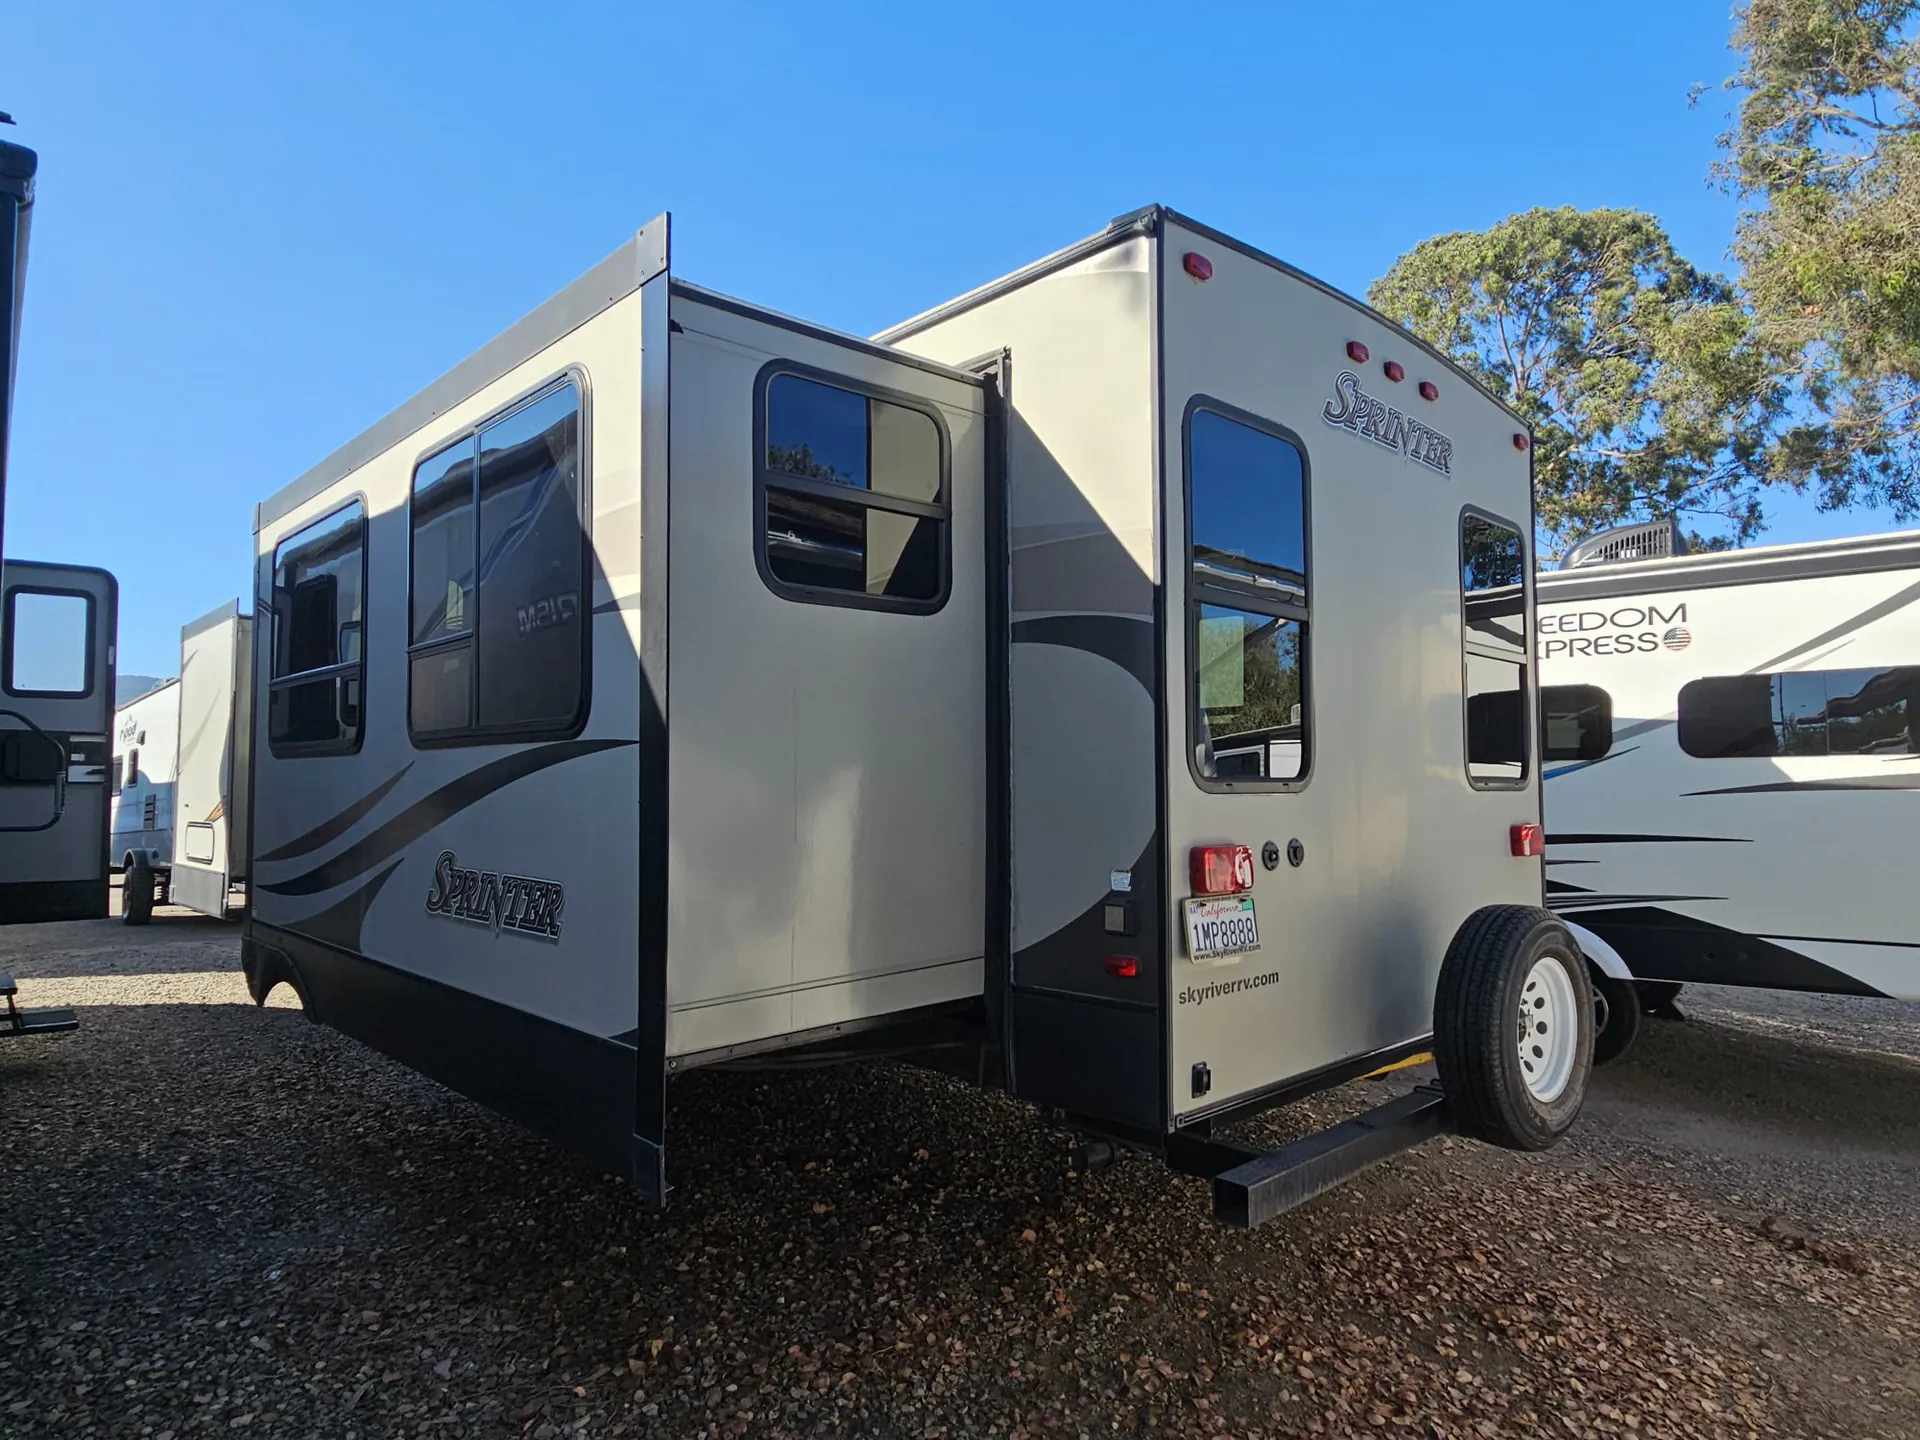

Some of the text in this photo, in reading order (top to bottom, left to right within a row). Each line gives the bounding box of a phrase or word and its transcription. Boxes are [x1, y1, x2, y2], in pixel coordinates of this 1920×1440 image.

[1322, 369, 1453, 476] SPRINTER
[1538, 602, 1688, 635] EEDOM
[1538, 632, 1659, 659] PRESS
[426, 849, 564, 938] SPRINTER
[1201, 902, 1240, 920] California
[1193, 917, 1255, 952] 1MP8888
[1179, 971, 1279, 1005] skyriverrv.com
